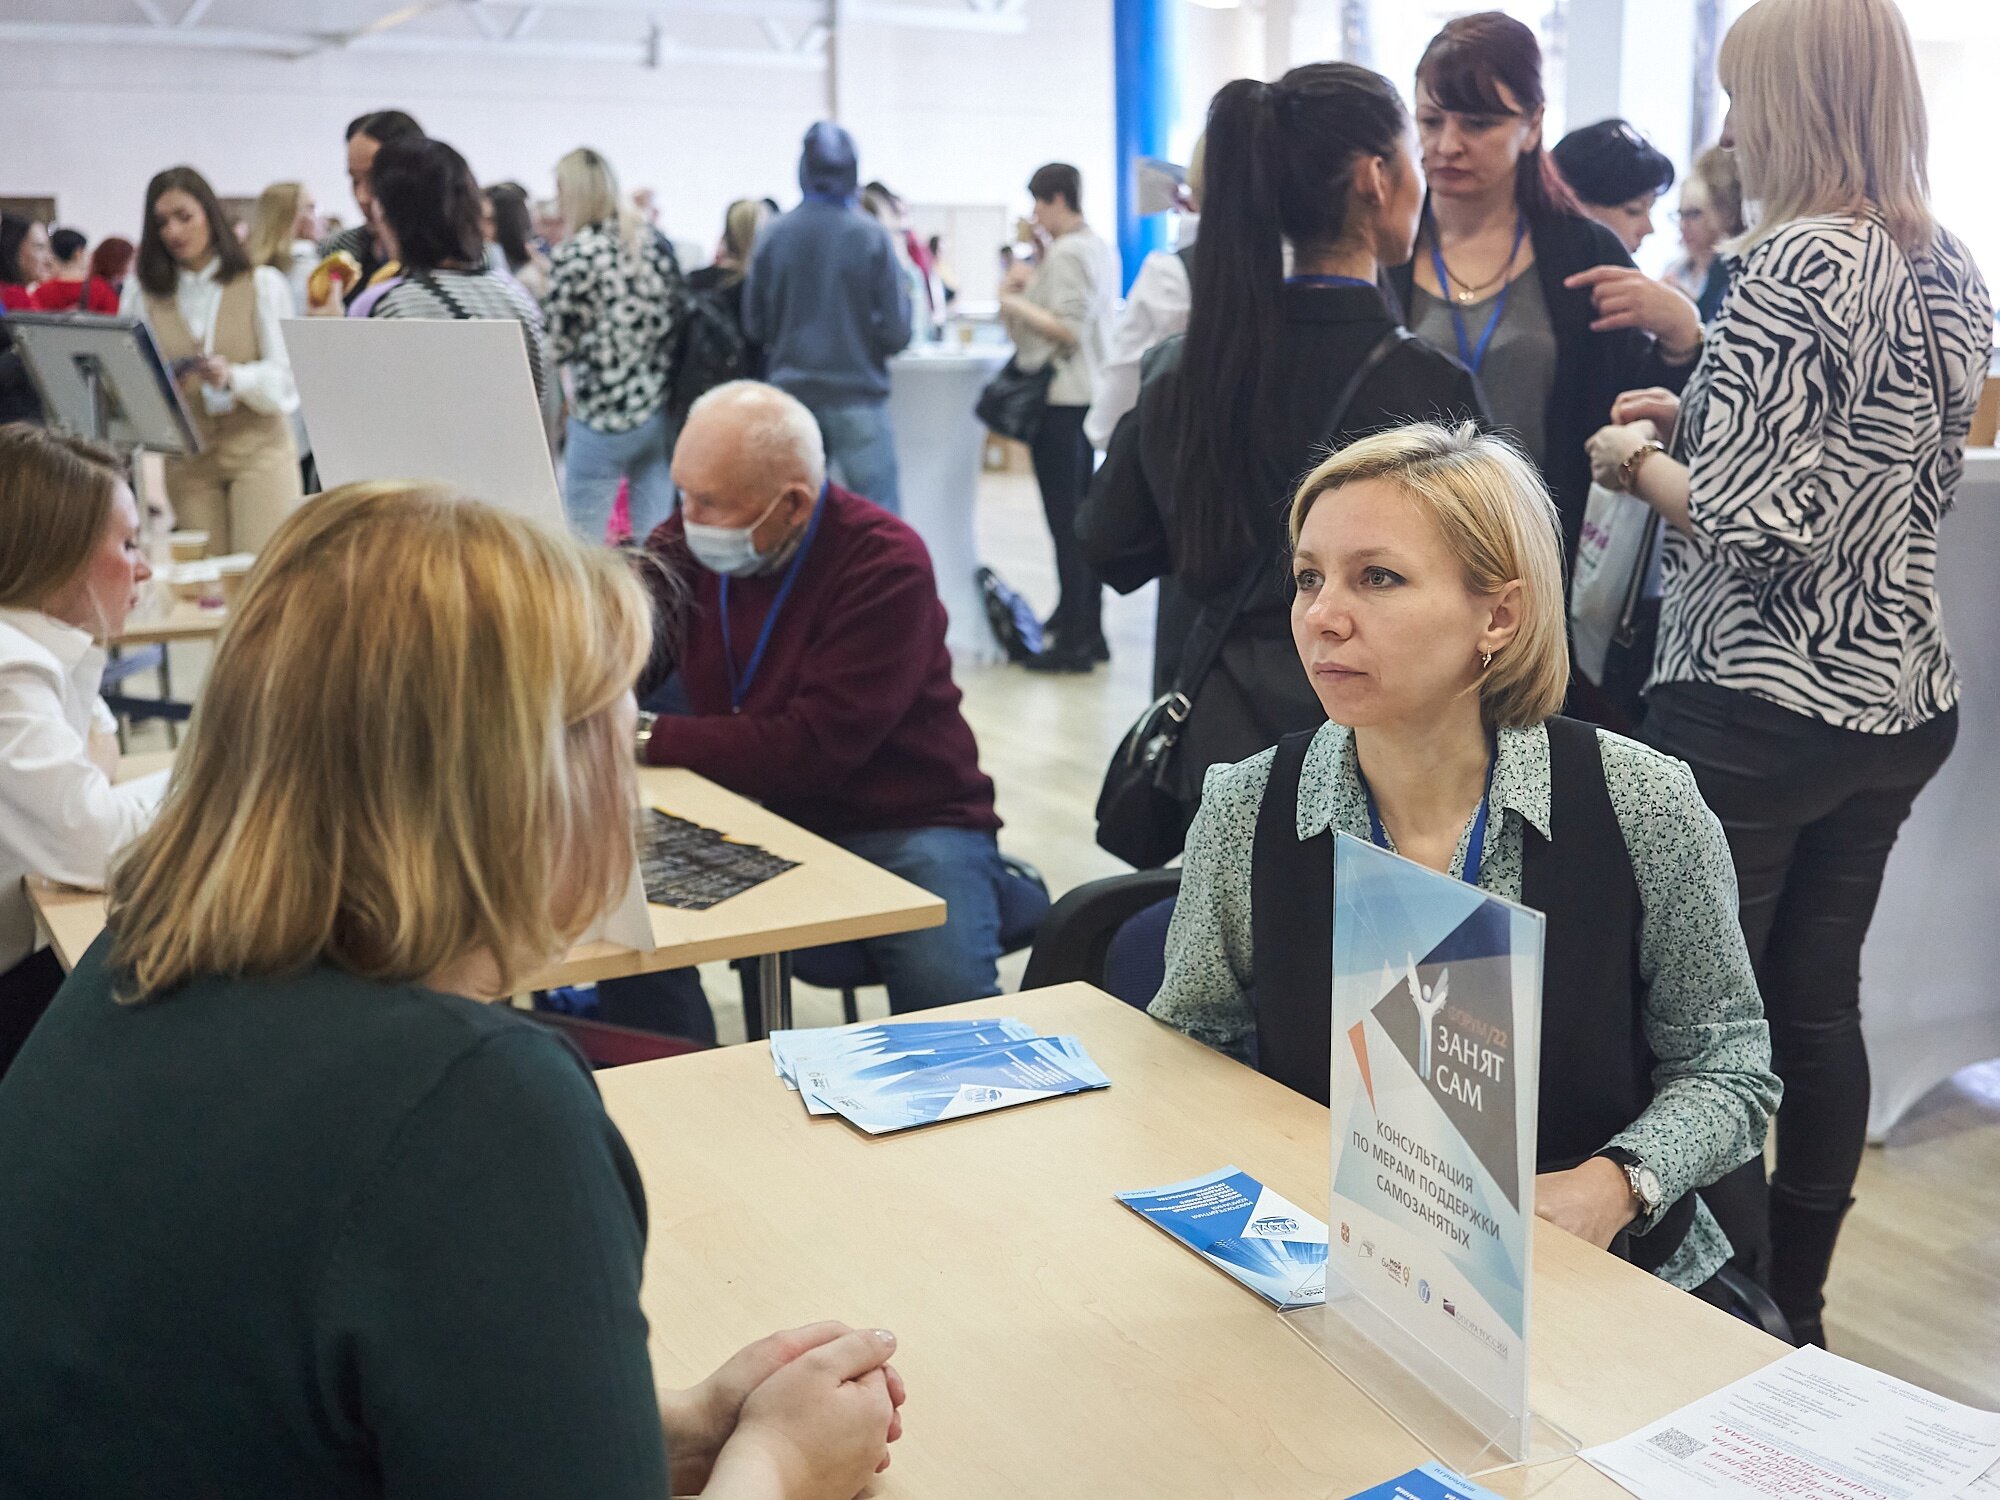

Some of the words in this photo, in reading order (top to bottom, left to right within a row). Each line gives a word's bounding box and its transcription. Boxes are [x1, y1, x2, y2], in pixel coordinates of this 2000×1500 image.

[1437, 1025, 1505, 1083] ЗАНЯТ
[1436, 1065, 1482, 1113] САМ
[1352, 1130, 1369, 1153] ПО
[1372, 1144, 1415, 1185] МЕРАМ
[1419, 1174, 1500, 1241] ПОДДЕРЖКИ
[1376, 1119, 1473, 1194] КОНСУЛЬТАЦИЯ
[1376, 1174, 1470, 1249] САМОЗАНЯТЫХ
[1713, 1425, 1784, 1457] КОНТРАКТ
